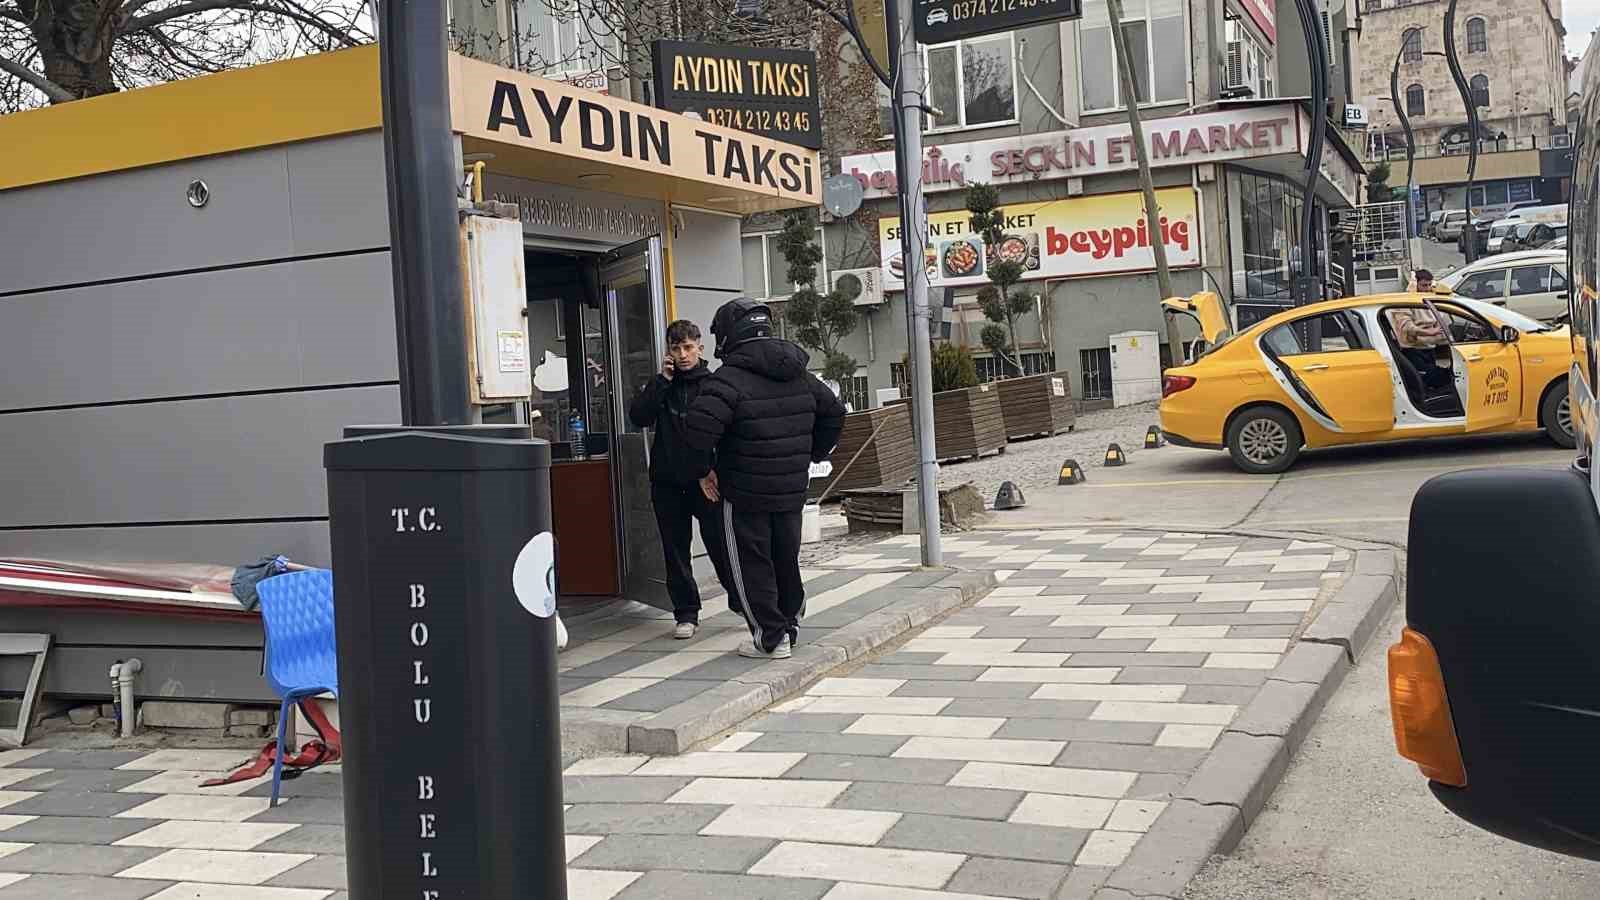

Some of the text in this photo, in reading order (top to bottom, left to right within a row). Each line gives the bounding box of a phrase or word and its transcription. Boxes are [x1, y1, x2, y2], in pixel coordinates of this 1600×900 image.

[952, 0, 987, 21] 0374
[673, 55, 743, 95] AYDIN
[486, 79, 672, 167] AYDIN
[706, 108, 810, 132] 0374 212 43 45
[990, 135, 1097, 179] SEÇKİN
[1107, 136, 1137, 164] ET
[1152, 118, 1289, 160] MARKET
[946, 221, 964, 235] ET
[1046, 216, 1189, 260] beypiiç
[391, 507, 443, 532] T.C.
[409, 583, 432, 723] BOLU
